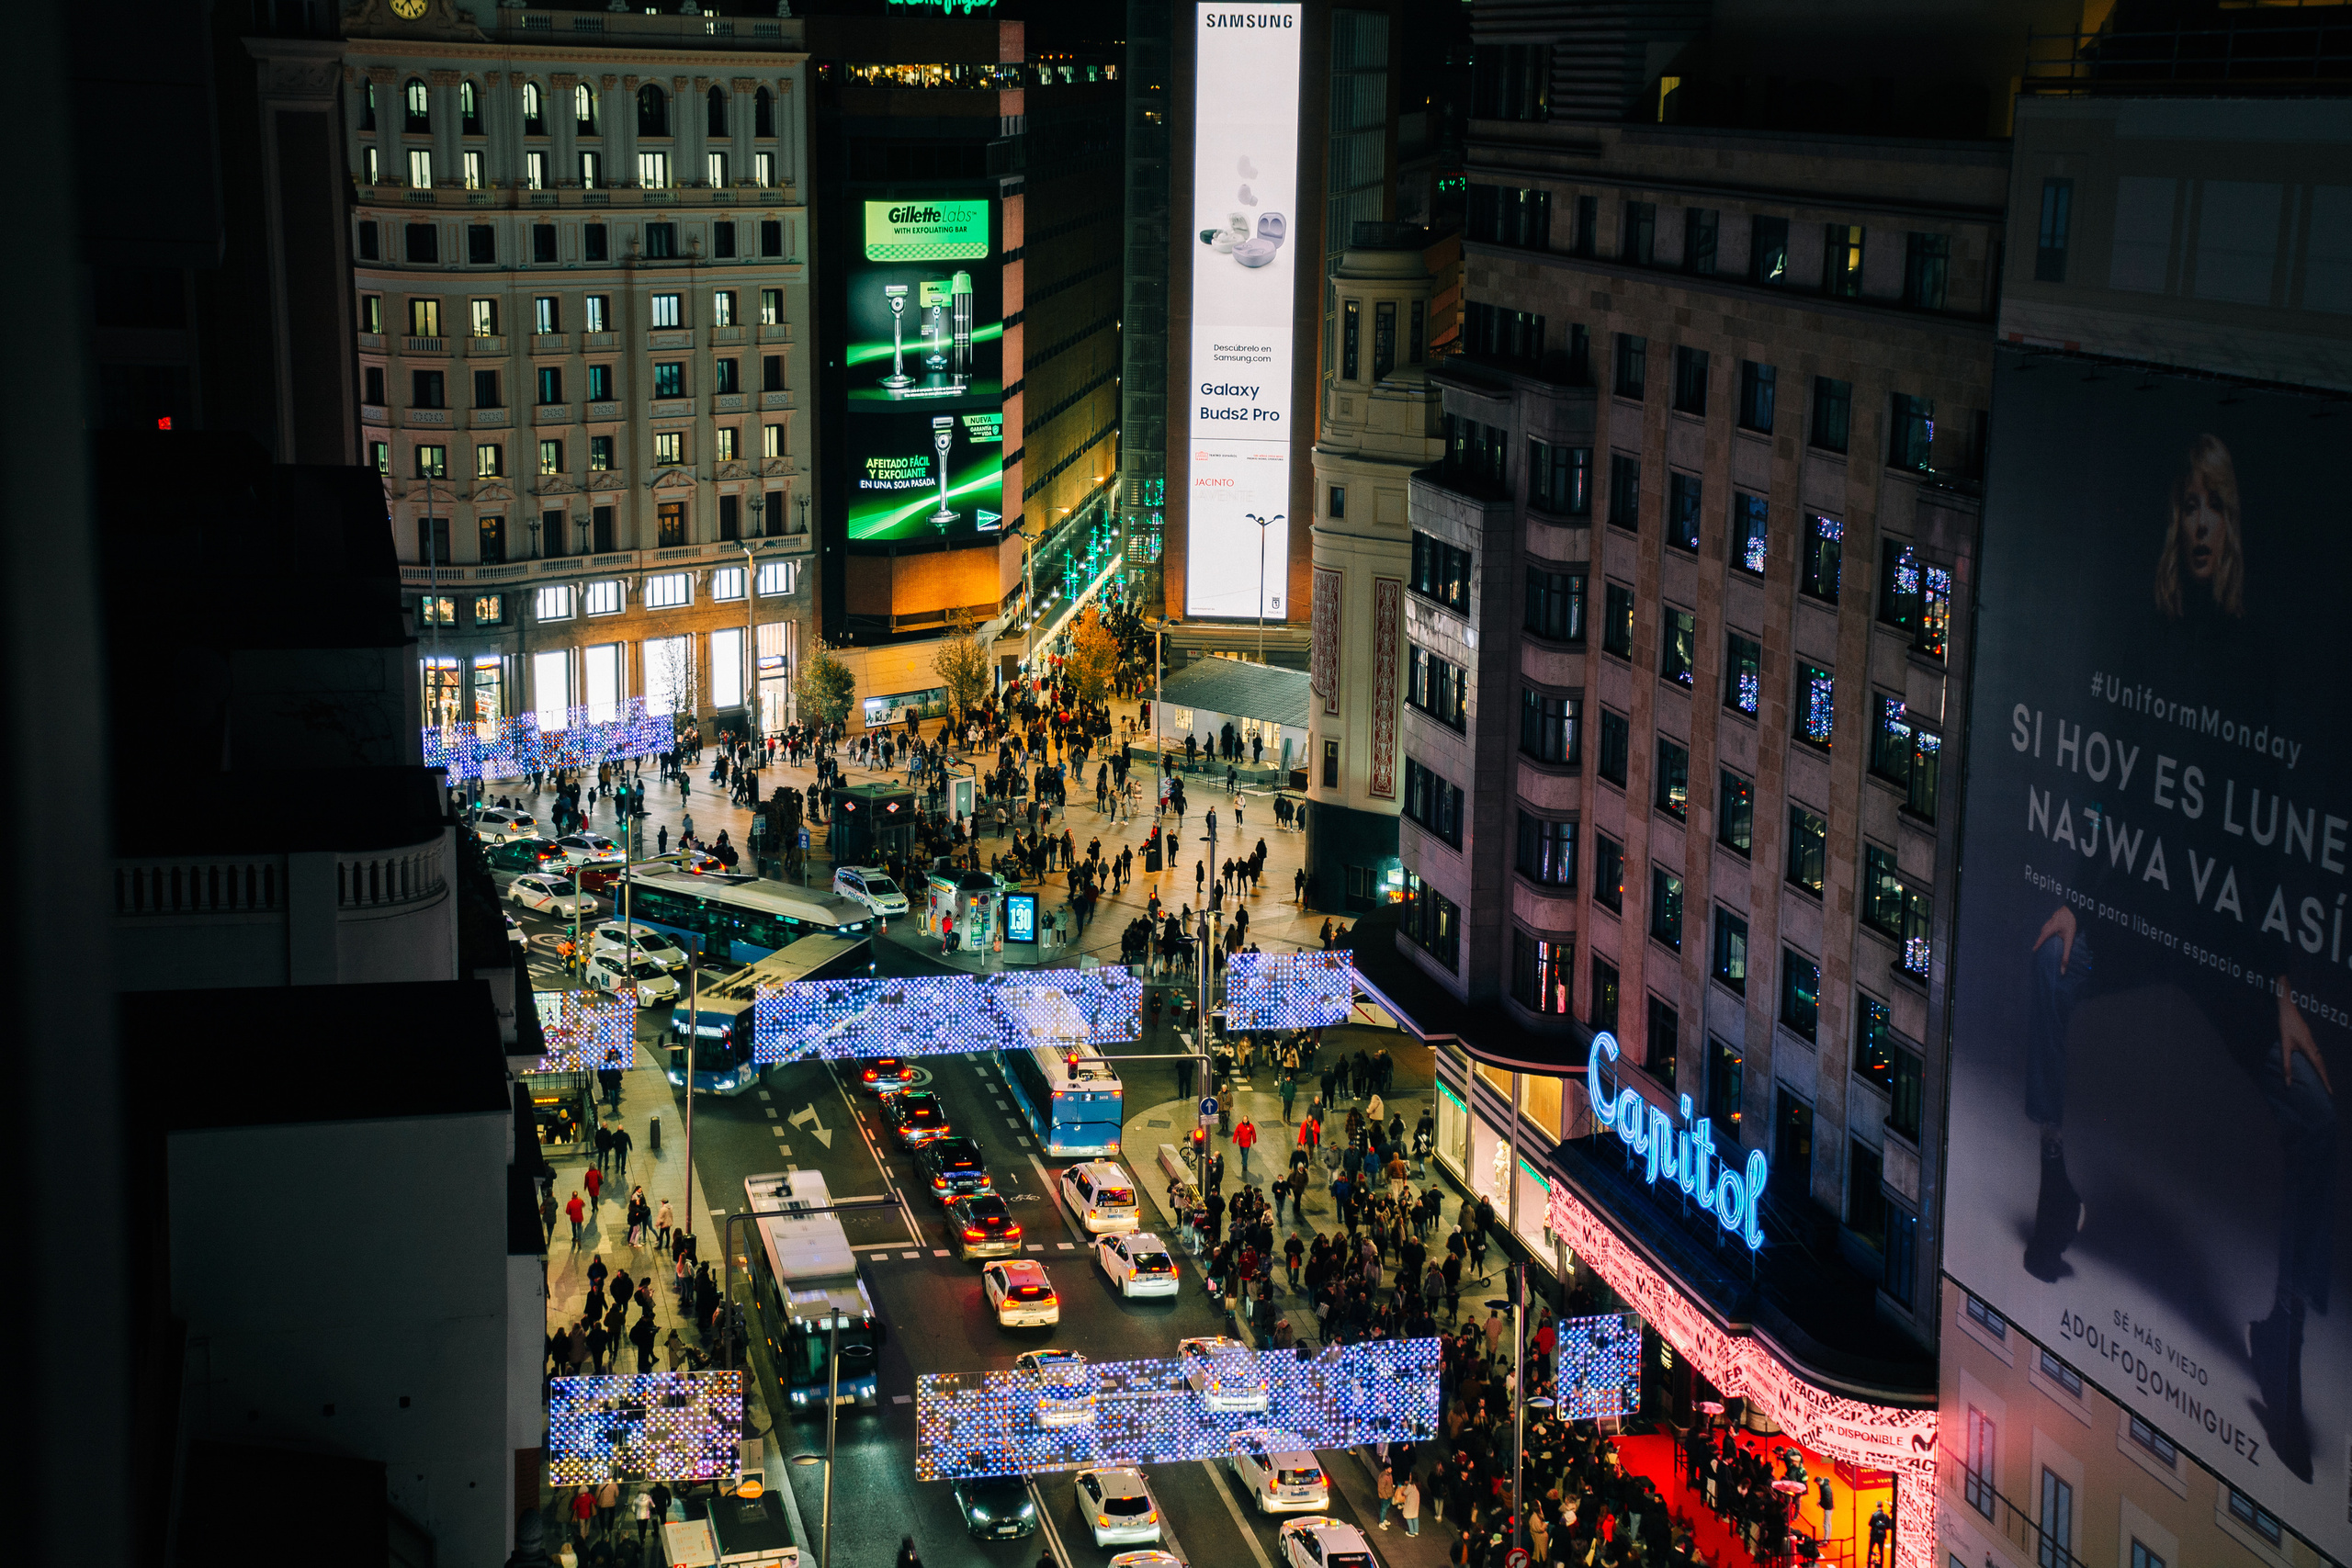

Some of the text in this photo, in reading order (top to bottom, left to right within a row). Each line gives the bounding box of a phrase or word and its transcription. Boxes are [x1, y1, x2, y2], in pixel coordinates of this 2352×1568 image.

[1206, 14, 1293, 28] SAMSUNG
[912, 226, 954, 234] EXFOLIATING
[1214, 344, 1259, 352] Descúbrelo
[1214, 354, 1272, 364] Samsung.com
[1201, 383, 1260, 400] Galaxy
[970, 416, 992, 424] NUEVA
[1200, 407, 1280, 422] Buds2 Pro
[866, 455, 930, 468] AFEITADO FÁCIL
[869, 468, 926, 479] Y EXFOLIANTE
[860, 478, 935, 490] EN UNA SOLA PASADA
[1194, 478, 1235, 487] JACINTO
[2091, 671, 2302, 770] #UniformMonday
[913, 760, 919, 769] P
[2011, 703, 2042, 758] SI
[2056, 718, 2140, 791] HOY
[2154, 754, 2206, 819] ES
[2028, 784, 2169, 891] NAJWA
[2188, 849, 2244, 922] VA
[1011, 908, 1032, 931] 130
[2025, 864, 2062, 896] Repite
[2066, 886, 2095, 910] ropa
[2098, 902, 2128, 927] para
[2132, 913, 2178, 950] liberar
[2184, 942, 2241, 978] espacio
[2245, 970, 2264, 989] en
[2269, 977, 2285, 998] tu
[1588, 1031, 1769, 1251] Capitol
[2113, 1310, 2209, 1386] SÉ MÁS VIEJO
[1824, 1421, 1904, 1446] YA DISPONIBLE
